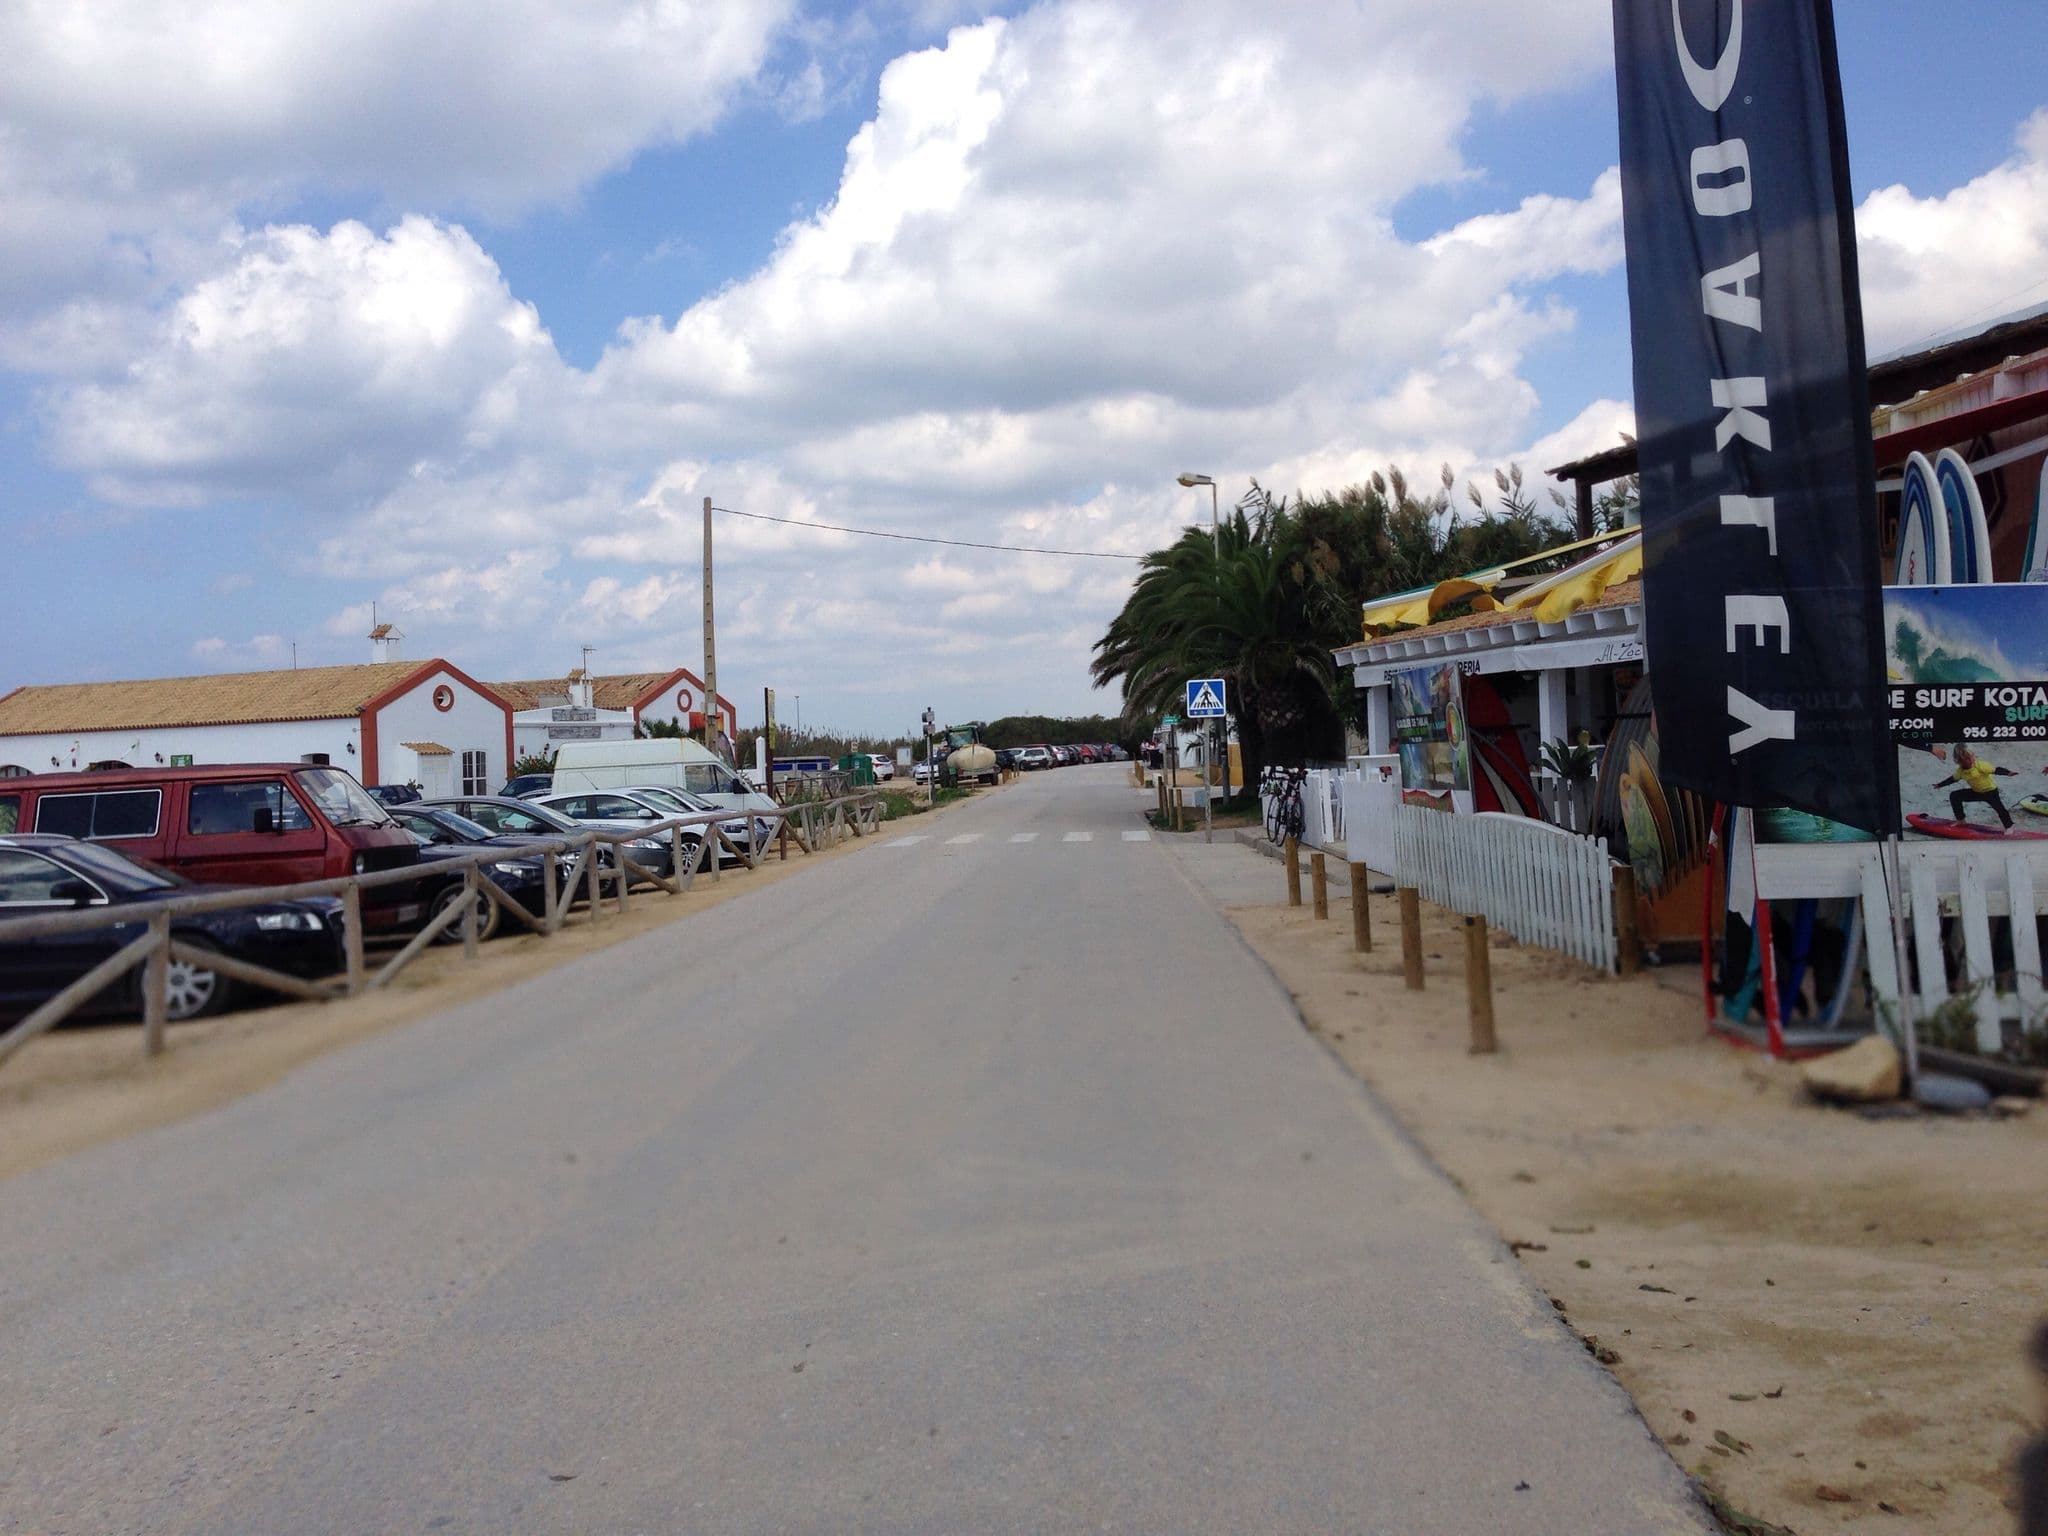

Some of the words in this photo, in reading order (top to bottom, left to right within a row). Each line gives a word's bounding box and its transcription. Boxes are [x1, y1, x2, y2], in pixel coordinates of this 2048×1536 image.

[1887, 689, 1905, 709] E
[1915, 687, 1975, 709] SURF
[1963, 726, 1988, 738] 956
[1993, 726, 2017, 738] 232
[2022, 725, 2046, 737] 000
